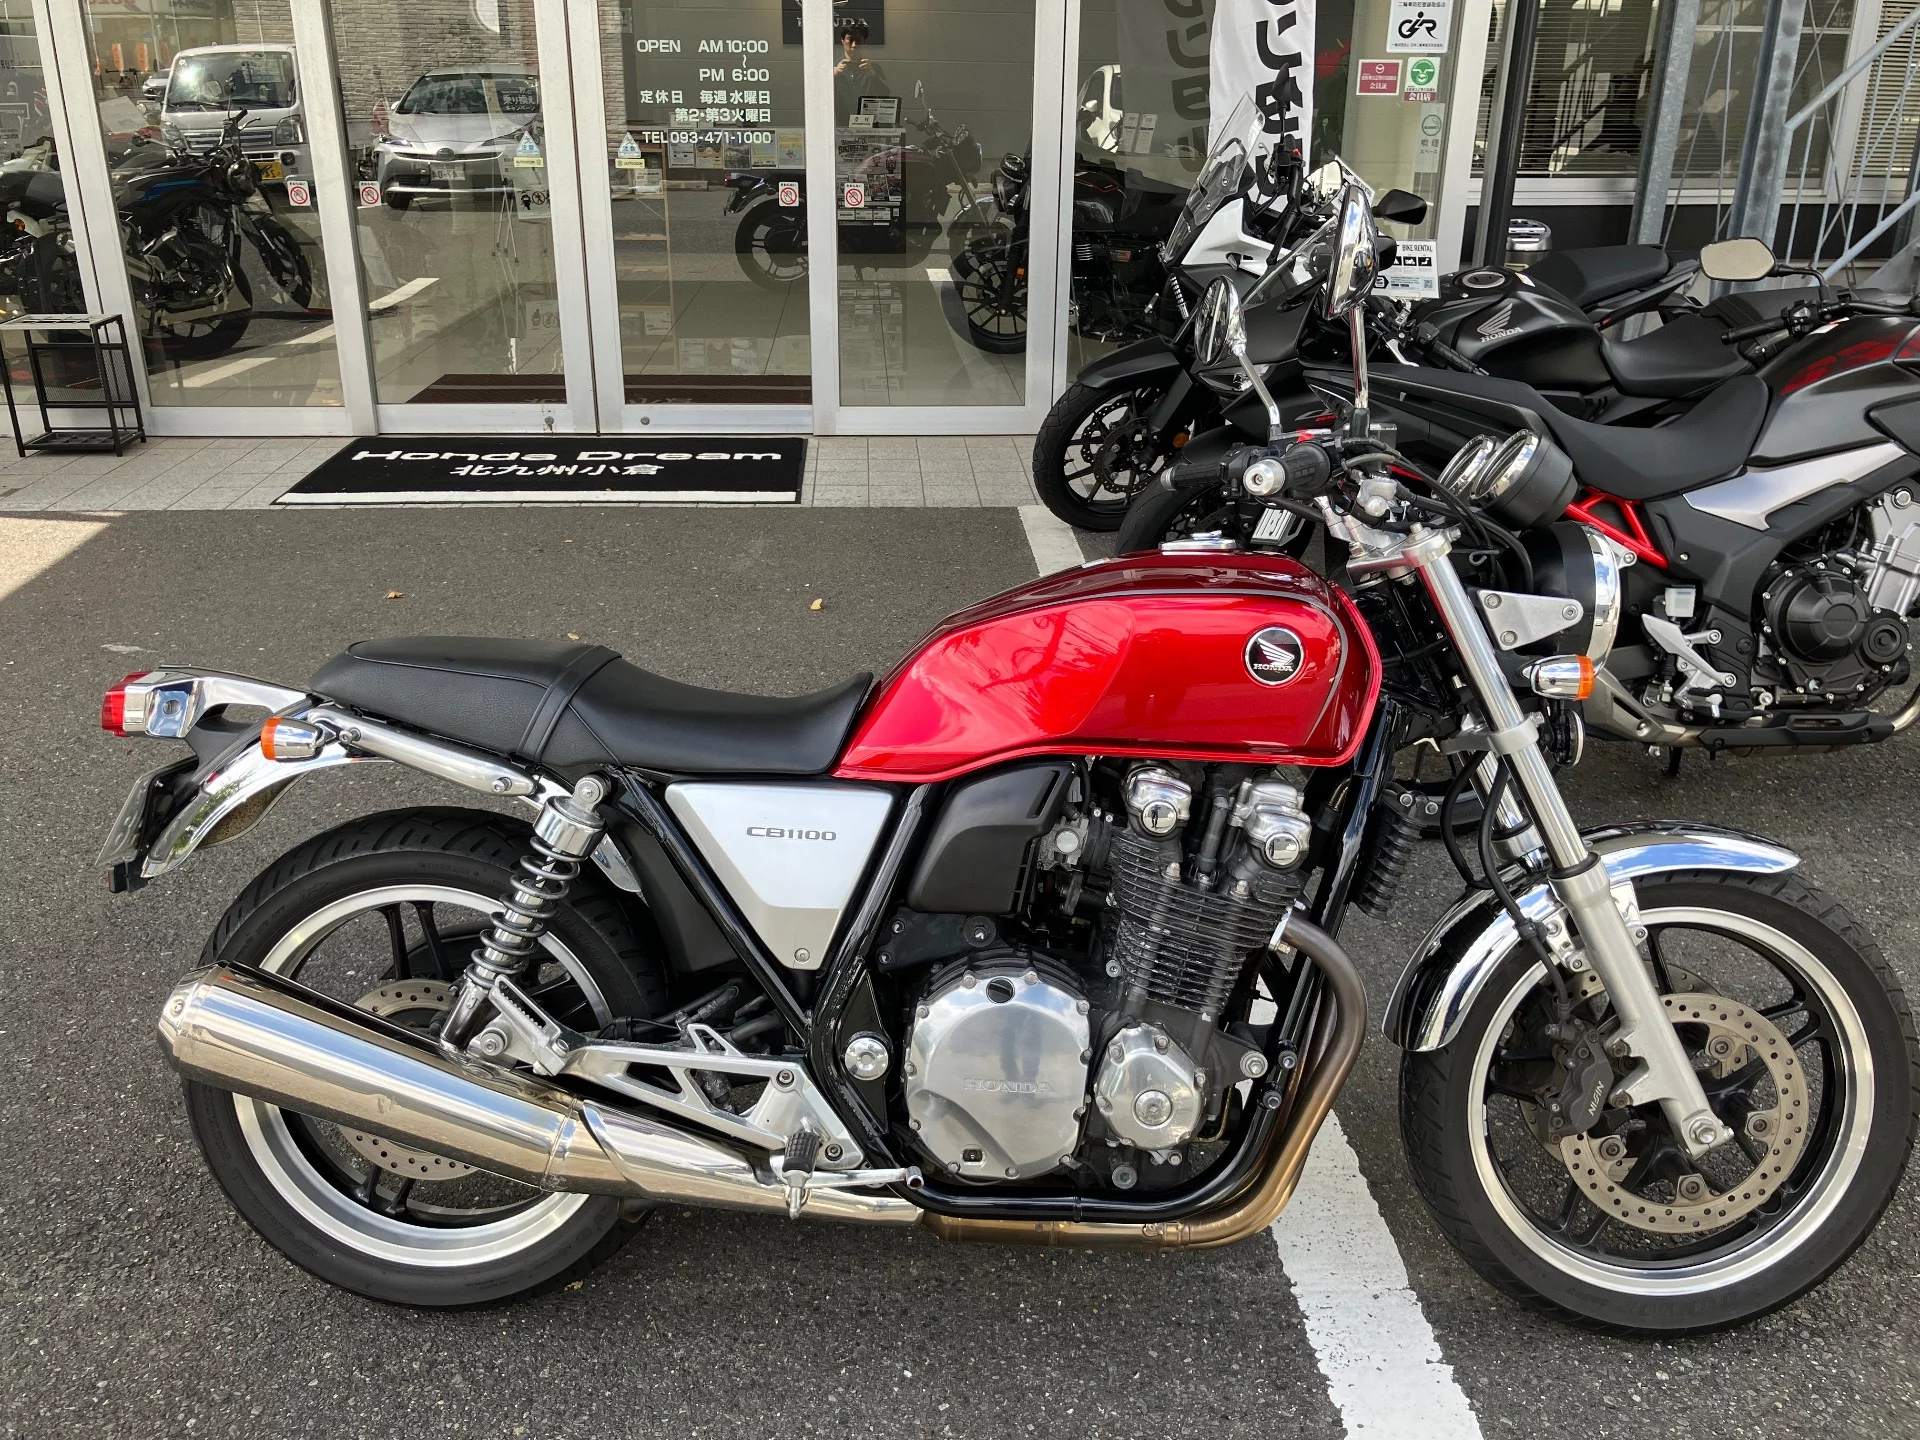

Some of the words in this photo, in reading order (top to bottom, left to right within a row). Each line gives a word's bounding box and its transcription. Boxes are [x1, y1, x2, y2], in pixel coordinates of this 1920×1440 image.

[636, 39, 681, 53] OPEN
[698, 39, 724, 53] AM
[725, 39, 769, 53] 10:00
[699, 68, 725, 82] PM
[731, 68, 770, 82] 6:00
[640, 89, 684, 104] 定休日
[699, 89, 771, 105] 毎週水曜日
[642, 131, 668, 144] TEL
[670, 131, 772, 144] 093-471-1000
[1402, 244, 1413, 252] BIKE
[1414, 244, 1433, 252] RENTAL
[1480, 327, 1524, 343] HONDA
[351, 450, 559, 462] Honda
[576, 450, 783, 462] Dream
[449, 463, 666, 477] 北九州小倉
[1253, 663, 1294, 672] HONDA
[746, 826, 837, 841] CB1100
[963, 1077, 1056, 1094] HONDA
[1588, 1080, 1605, 1117] NISSIN
